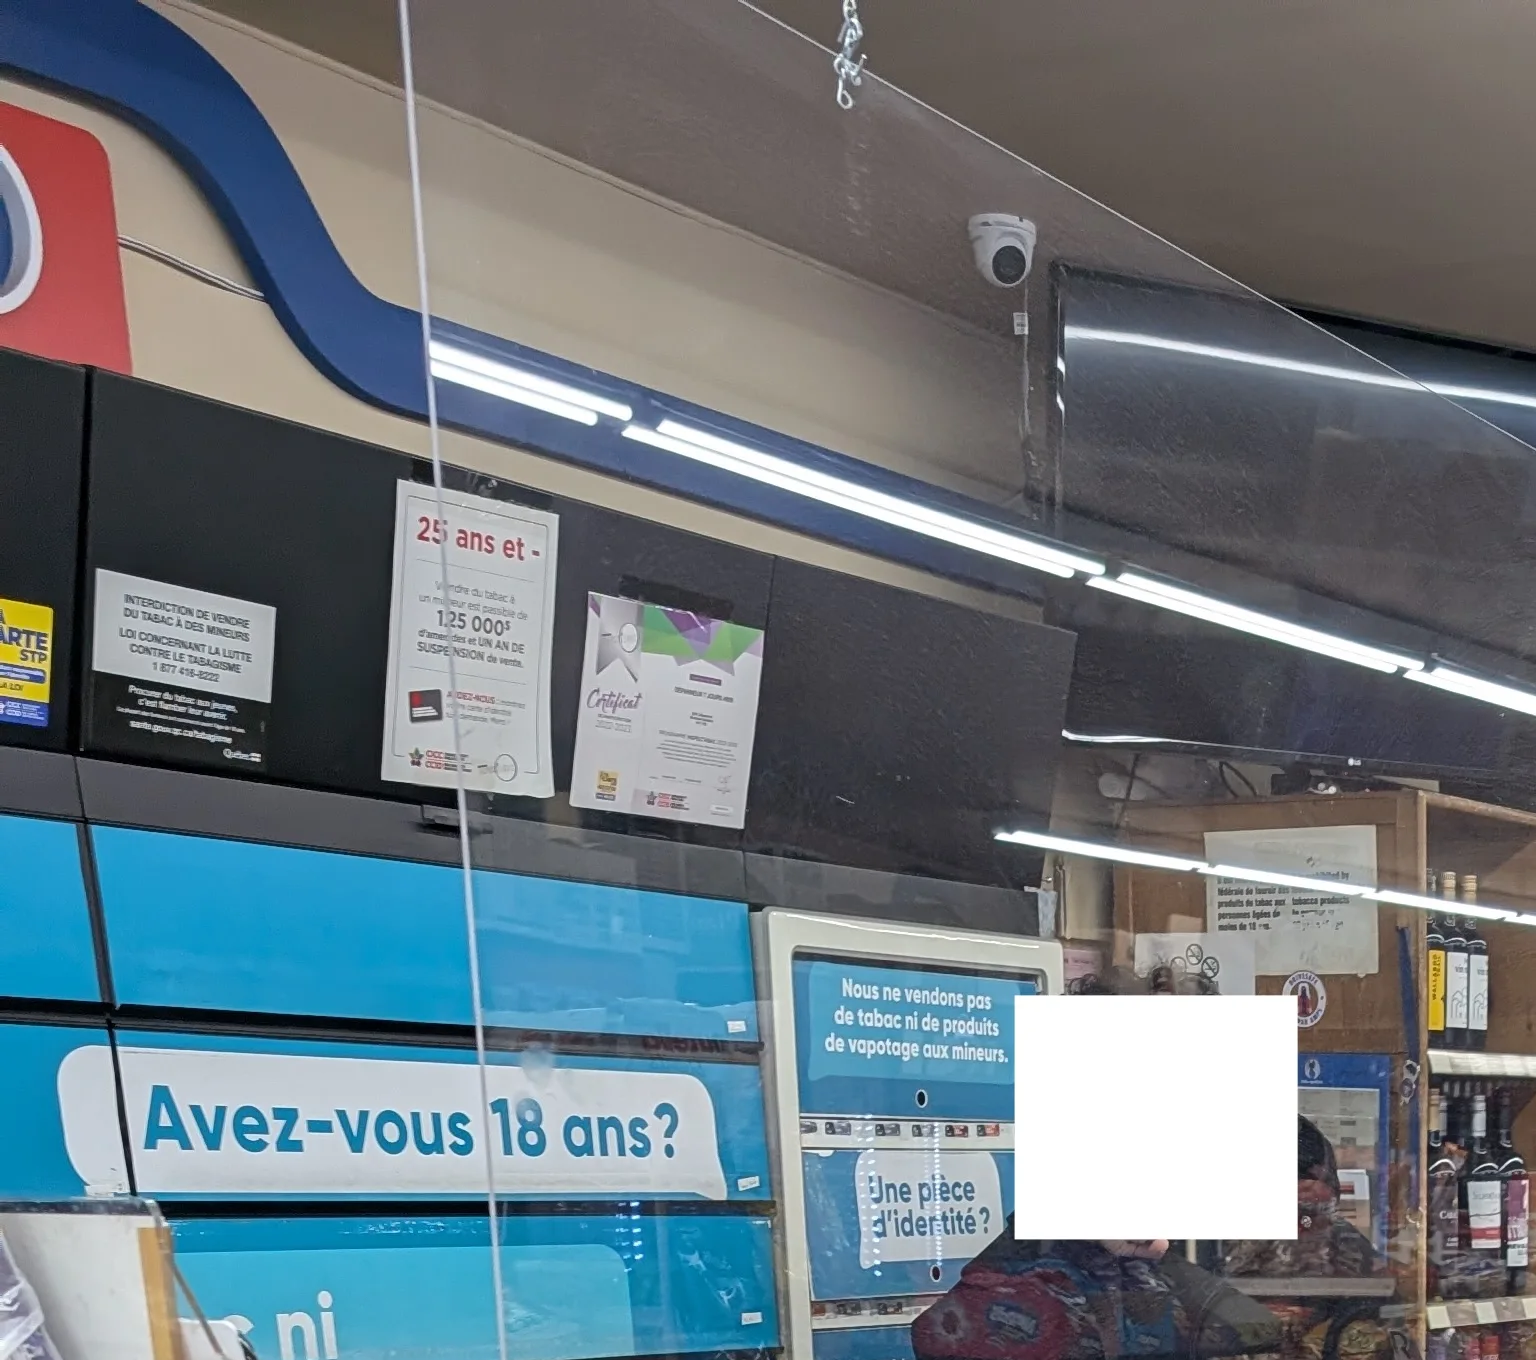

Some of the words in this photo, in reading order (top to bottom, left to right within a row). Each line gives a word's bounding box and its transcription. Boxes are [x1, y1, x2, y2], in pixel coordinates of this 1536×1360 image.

[417, 517, 448, 545] 25
[456, 528, 495, 554] ans
[503, 538, 525, 561] et
[123, 594, 193, 617] INTERDICTION
[196, 609, 209, 620] DE
[212, 612, 250, 629] VENDRE
[123, 608, 139, 619] DU
[142, 611, 173, 626] TABAC
[185, 620, 204, 633] DES
[207, 625, 250, 642] MINEURS
[437, 610, 466, 629] 125
[20, 650, 47, 664] STP
[119, 627, 137, 640] LOI
[138, 631, 206, 654] CONCERNANT
[208, 646, 221, 657] LA
[223, 647, 252, 662] LUTTE
[129, 643, 170, 660] CONTRE
[172, 651, 186, 662] LE
[188, 653, 242, 674] TABAGISME
[478, 637, 493, 648] UN
[495, 640, 510, 652] AN
[512, 643, 525, 654] DE
[842, 977, 880, 1000] Nous
[883, 987, 901, 1002] ne
[904, 987, 964, 1008] vendons
[966, 993, 992, 1013] pas
[834, 1006, 854, 1026] de
[857, 1008, 902, 1029] tabac
[905, 1011, 918, 1030] ni
[921, 1012, 939, 1032] de
[943, 1016, 1000, 1037] produits
[825, 1032, 845, 1053] de
[848, 1037, 919, 1062] vapotage
[922, 1046, 949, 1059] aux
[952, 1042, 1009, 1064] mineurs.
[142, 1083, 474, 1158] Avez-vous
[489, 1096, 548, 1158] 18
[868, 1175, 912, 1203] Une
[918, 1173, 975, 1209] pièce
